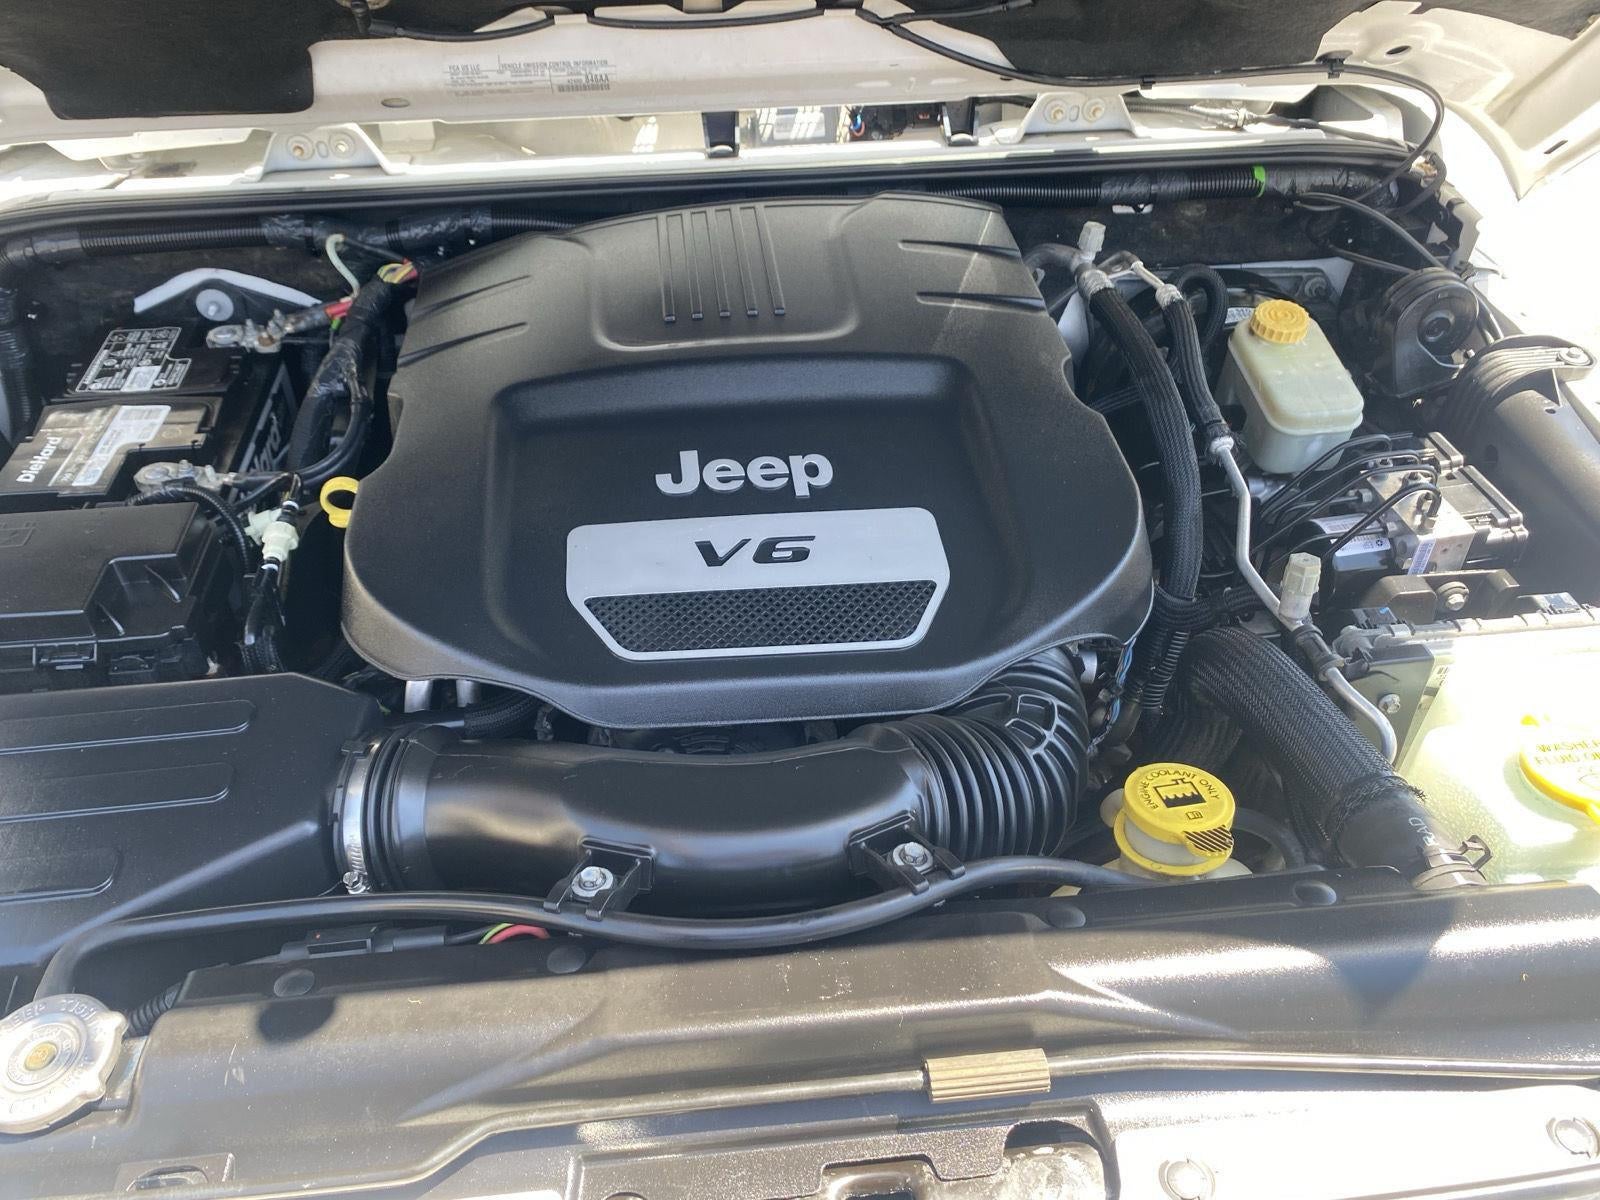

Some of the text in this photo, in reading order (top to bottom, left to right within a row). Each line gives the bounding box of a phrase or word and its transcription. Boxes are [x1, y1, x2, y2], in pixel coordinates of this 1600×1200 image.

[16, 436, 62, 483] DieHard
[655, 450, 834, 499] Jeep
[694, 535, 816, 568] V6
[1140, 769, 1220, 810] ENGINE COOLANT ONLY
